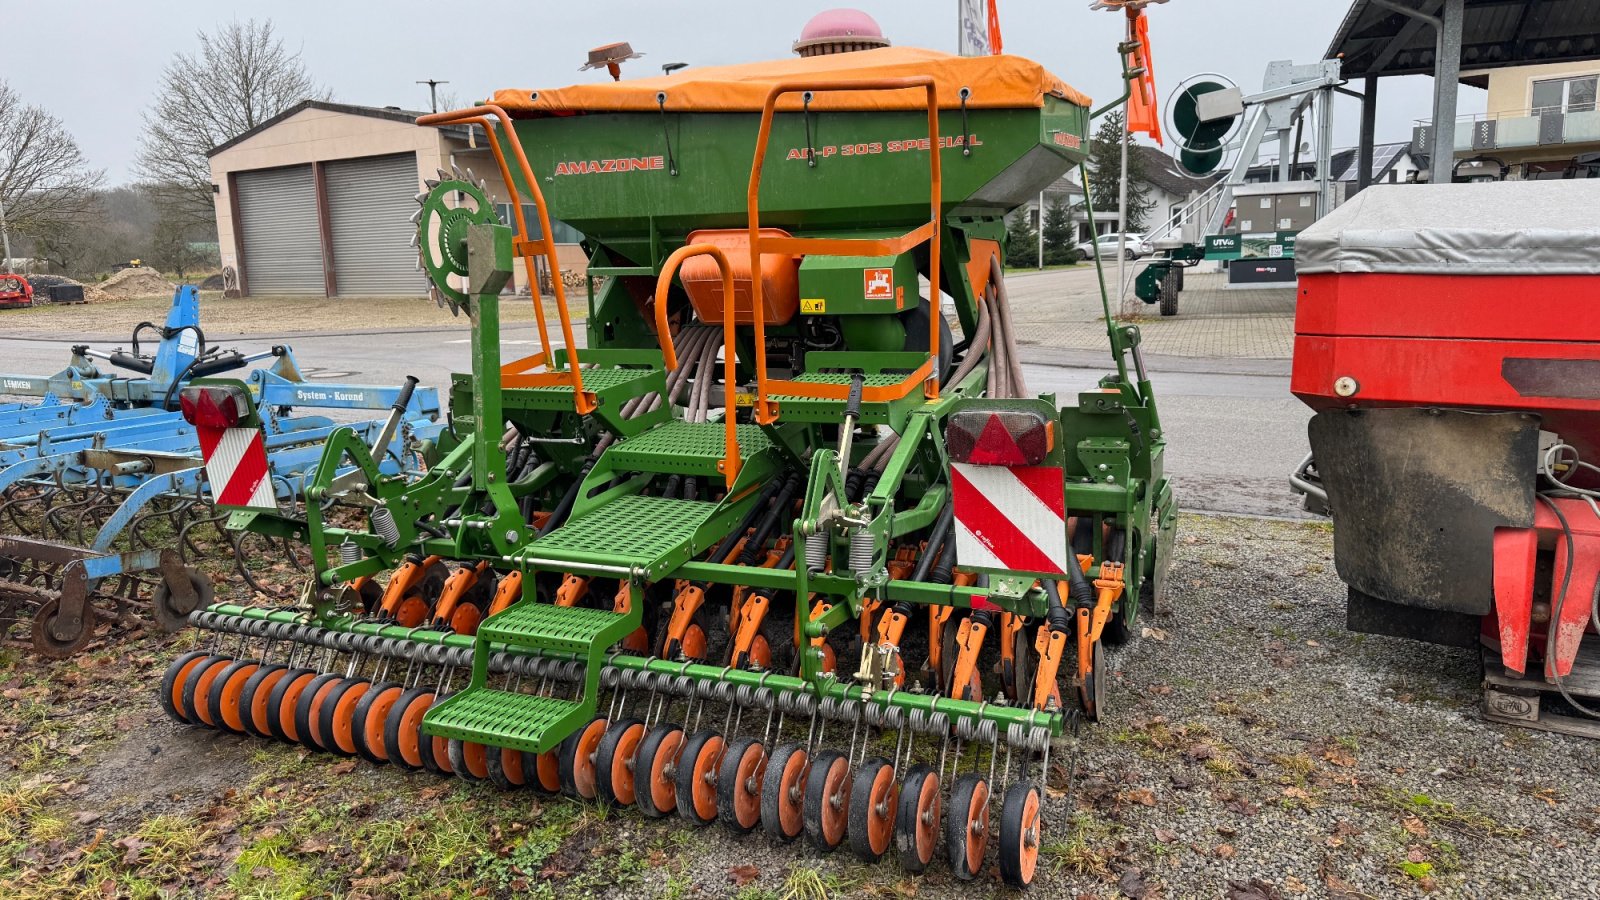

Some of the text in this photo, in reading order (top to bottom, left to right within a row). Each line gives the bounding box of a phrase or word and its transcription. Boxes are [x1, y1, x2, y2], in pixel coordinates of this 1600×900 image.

[786, 145, 837, 160] AD-P
[841, 142, 883, 156] 303
[554, 156, 664, 176] AMAZONE
[4, 379, 31, 389] LEMKEN
[297, 390, 326, 401] System
[334, 391, 363, 401] Korund
